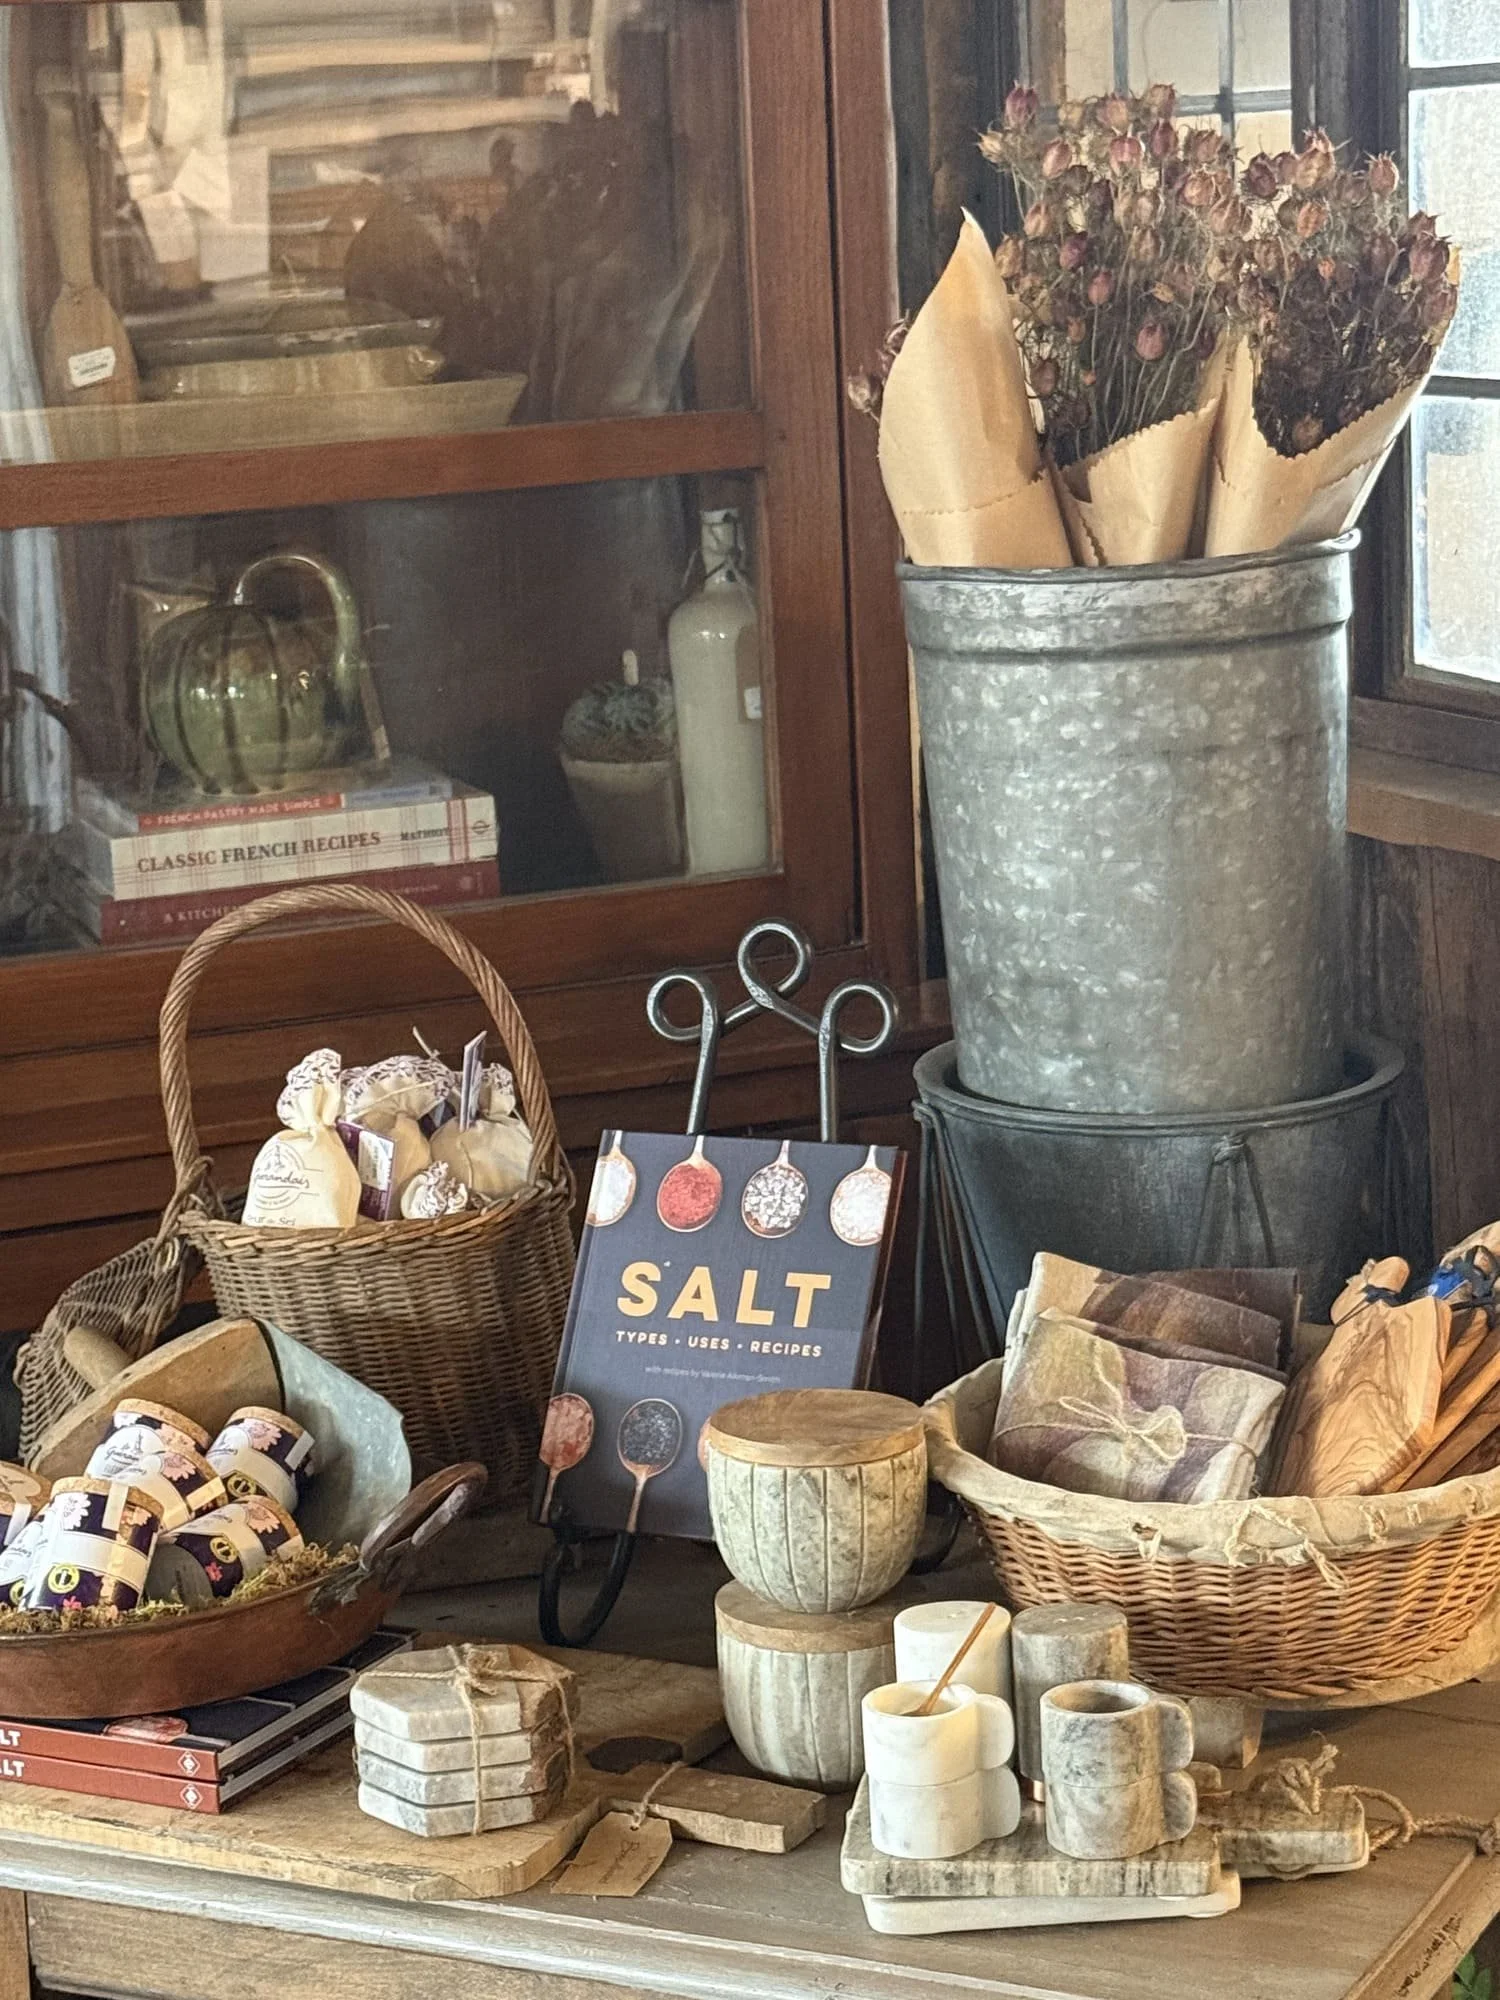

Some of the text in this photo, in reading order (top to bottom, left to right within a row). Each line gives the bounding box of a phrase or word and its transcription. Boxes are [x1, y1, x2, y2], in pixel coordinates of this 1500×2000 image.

[157, 798, 321, 825] FRENCH PASTRY MADE SIMPLE
[138, 832, 381, 873] CLASSIC FRENCH RECIPES
[163, 912, 174, 924] A
[616, 1261, 832, 1329] SALT
[616, 1330, 822, 1358] TYPES USES RECIPES
[0, 1759, 25, 1778] LT
